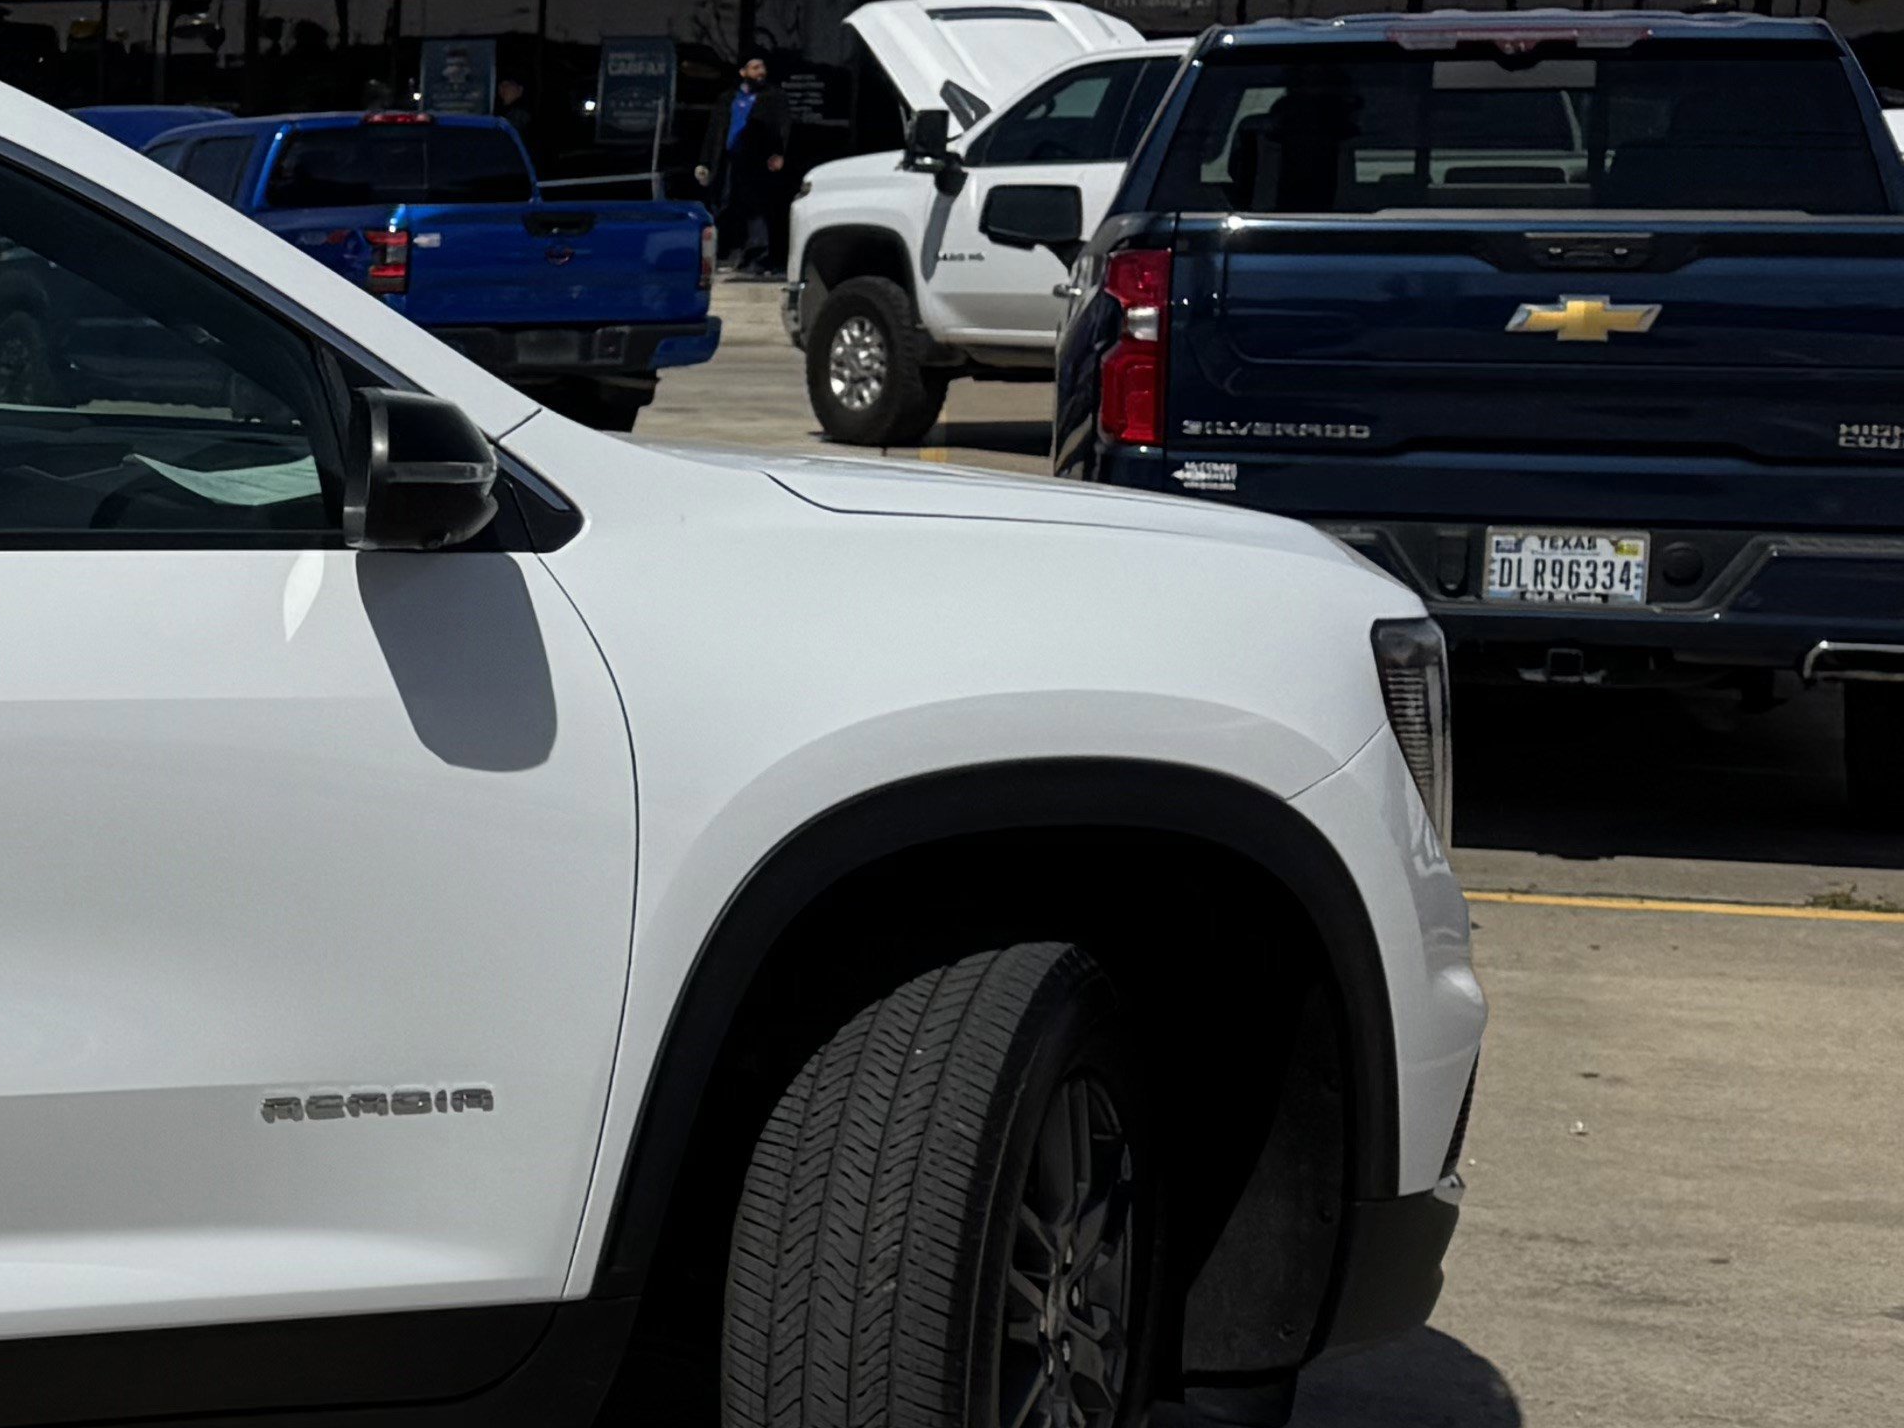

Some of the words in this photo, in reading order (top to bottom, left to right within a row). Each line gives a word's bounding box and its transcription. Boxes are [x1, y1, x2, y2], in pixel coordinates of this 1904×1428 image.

[1181, 418, 1371, 439] SILVERADO
[1838, 435, 1904, 449] COU
[1538, 535, 1598, 550] TEXAS
[1498, 556, 1632, 591] DLR96334
[261, 1087, 494, 1124] ACADIA
